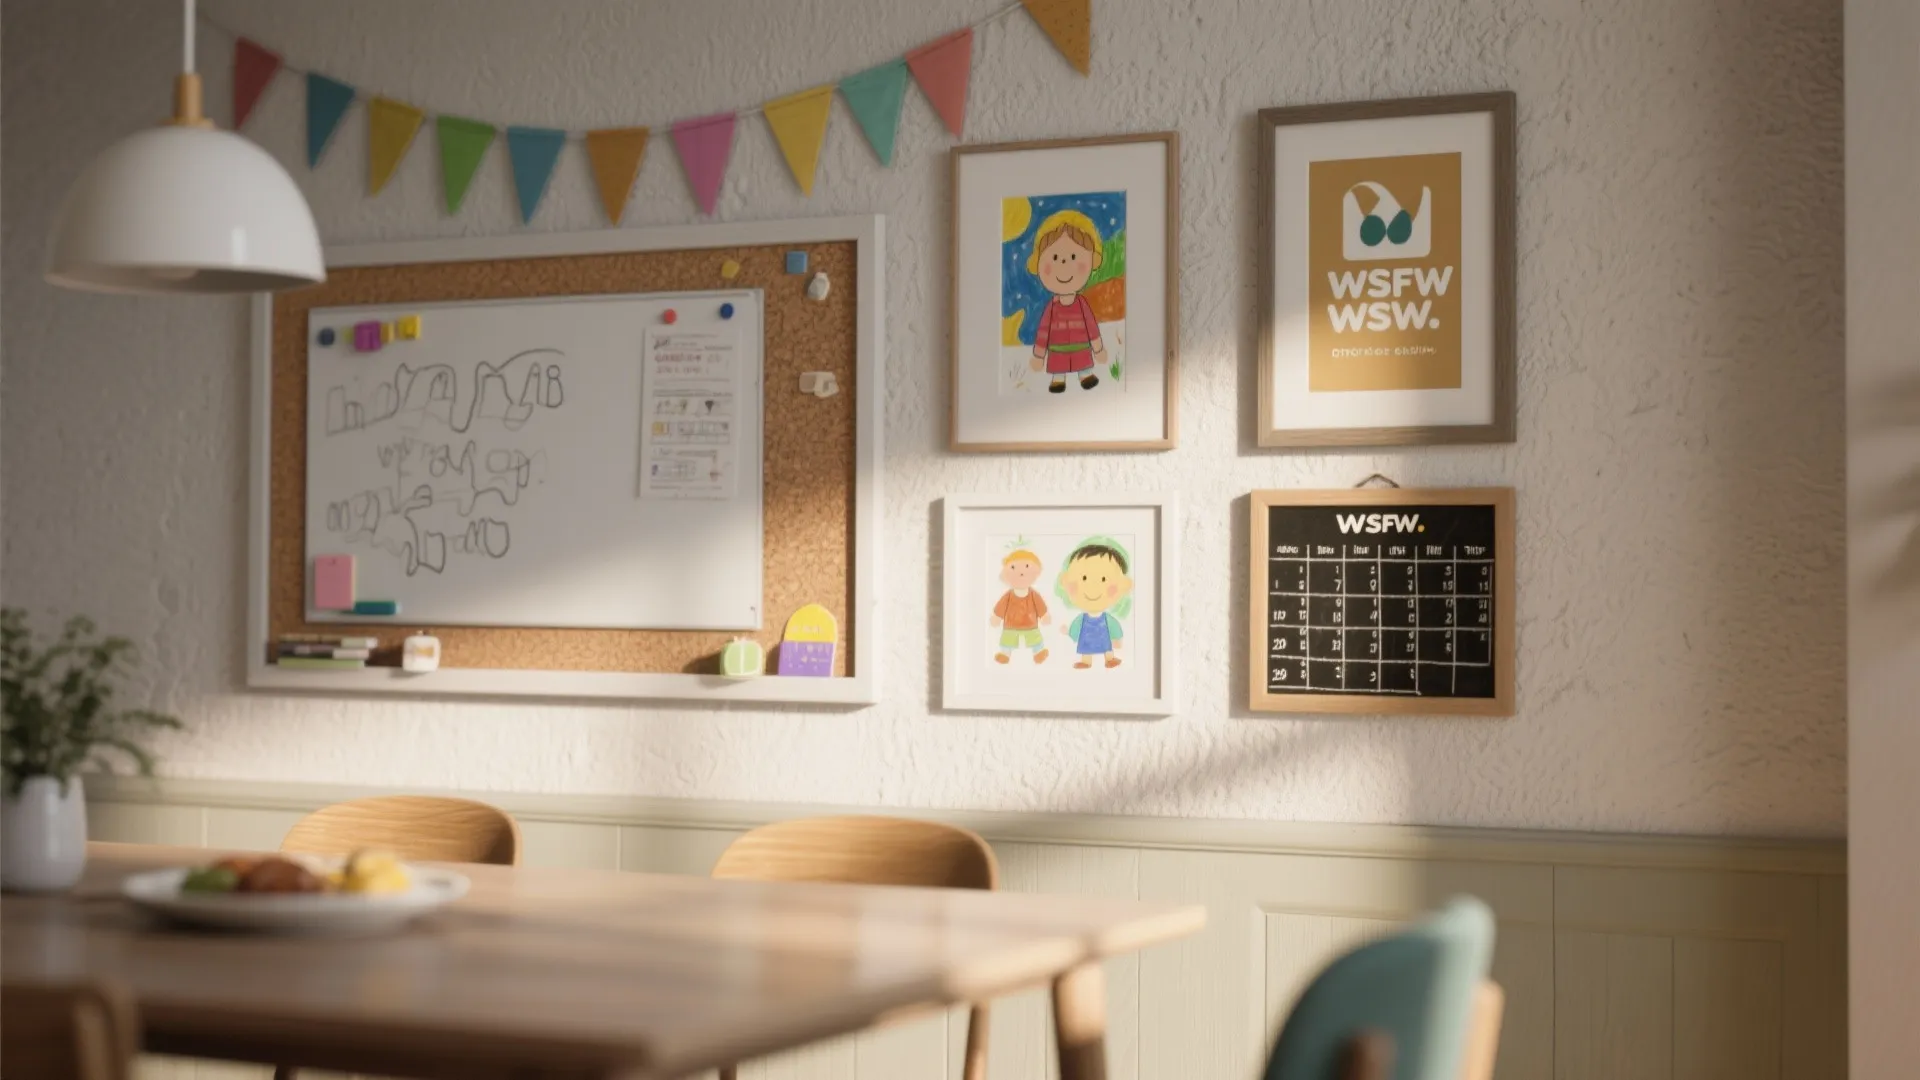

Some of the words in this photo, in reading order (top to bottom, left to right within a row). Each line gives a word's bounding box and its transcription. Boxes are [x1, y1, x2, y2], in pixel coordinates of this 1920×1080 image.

[1328, 266, 1453, 299] WSFW
[1328, 300, 1440, 333] WSW.
[1336, 513, 1425, 534] WSFW.
